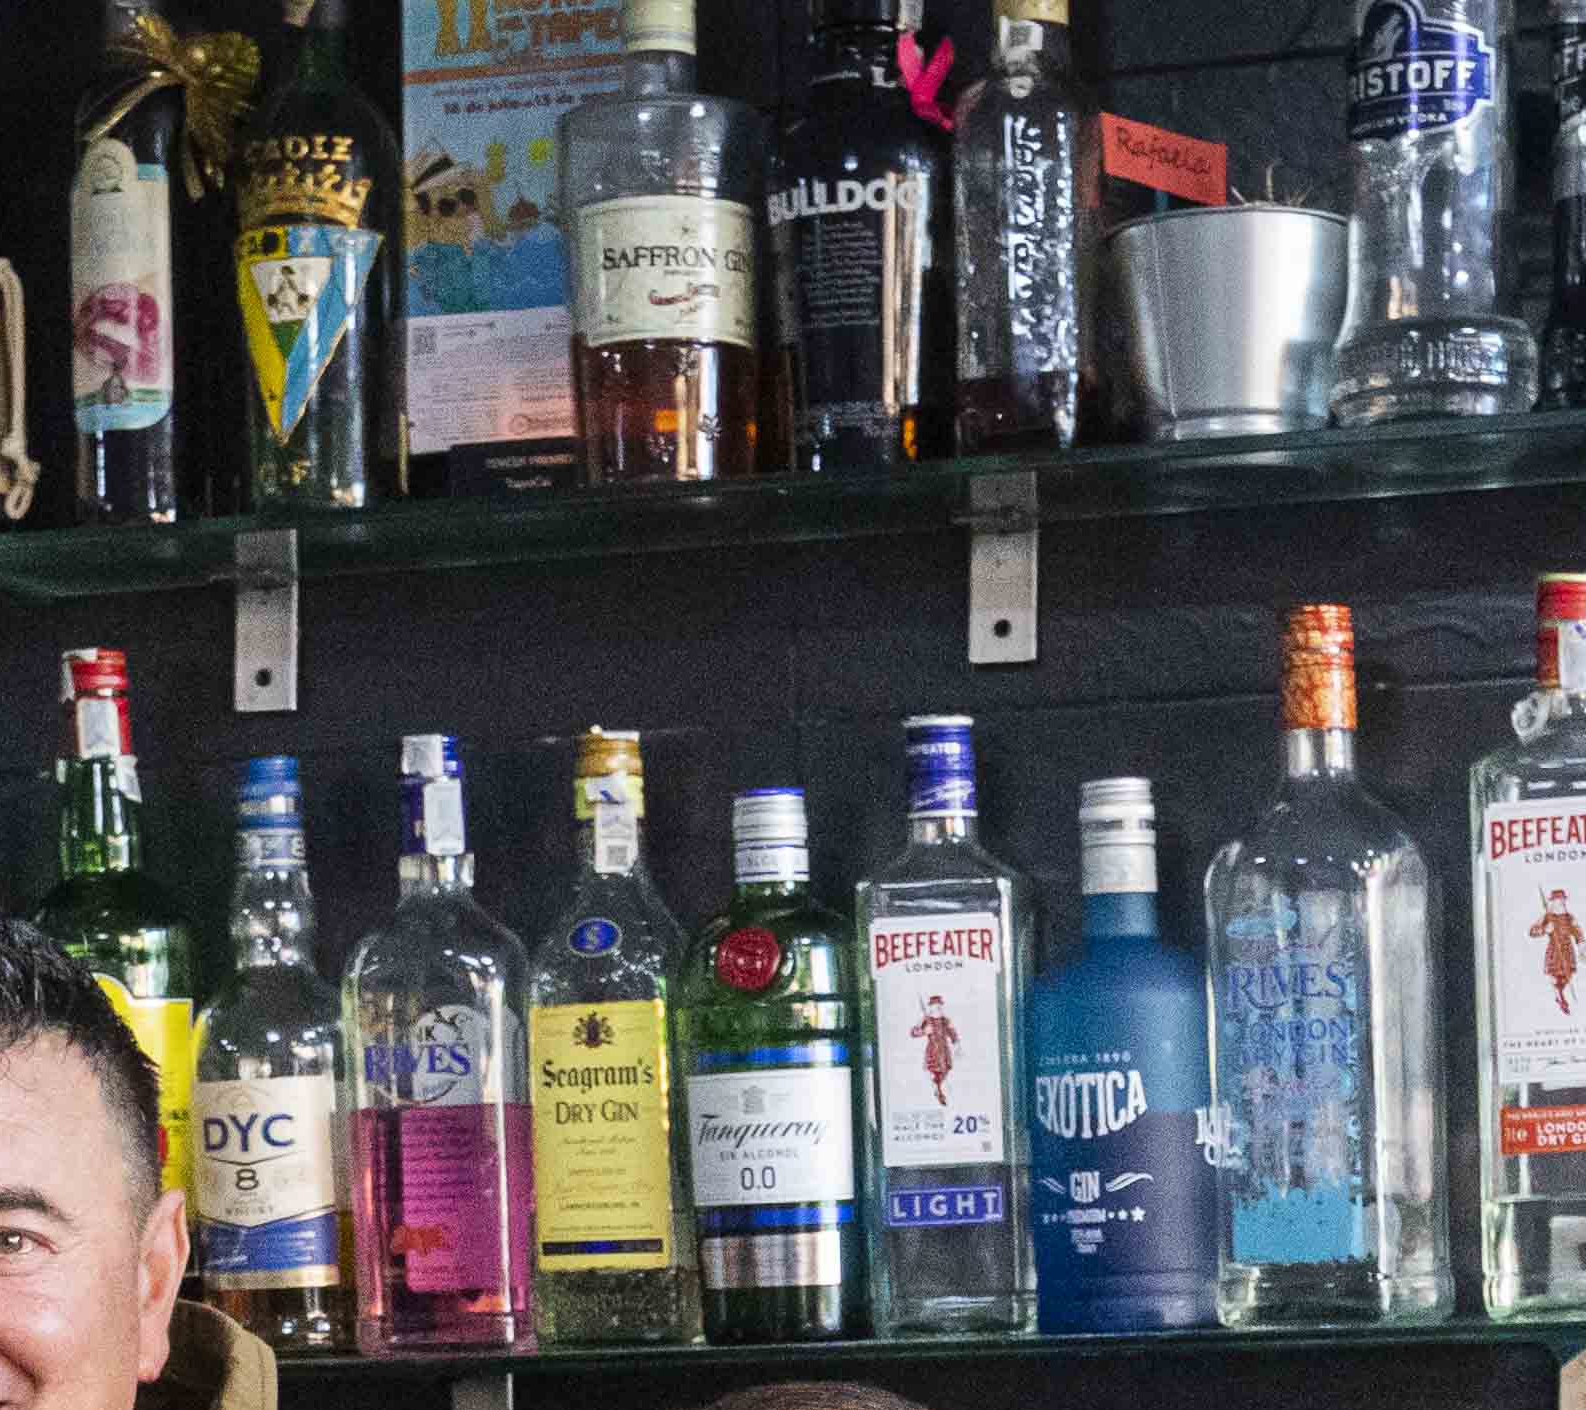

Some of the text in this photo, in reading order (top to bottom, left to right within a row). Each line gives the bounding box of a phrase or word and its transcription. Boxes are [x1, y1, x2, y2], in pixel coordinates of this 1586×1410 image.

[1348, 59, 1477, 103] RISTOFF
[767, 175, 925, 226] BULLDOG
[602, 244, 718, 271] SAFFRON
[874, 927, 995, 970] BEEFEATER
[904, 960, 965, 974] LONDON
[1227, 960, 1349, 1011] RIVES
[541, 1058, 655, 1094] Seagram's
[555, 1099, 640, 1125] DRY GIN
[202, 1112, 296, 1154] DYC
[697, 1112, 827, 1150] Tanqueray
[1536, 1133, 1567, 1147] DRY
[742, 1149, 800, 1161] ALCOHOL
[234, 1167, 259, 1192] 8
[739, 1165, 777, 1191] 0.0
[1069, 1170, 1101, 1203] GIN
[891, 1190, 1001, 1219] LIGHT
